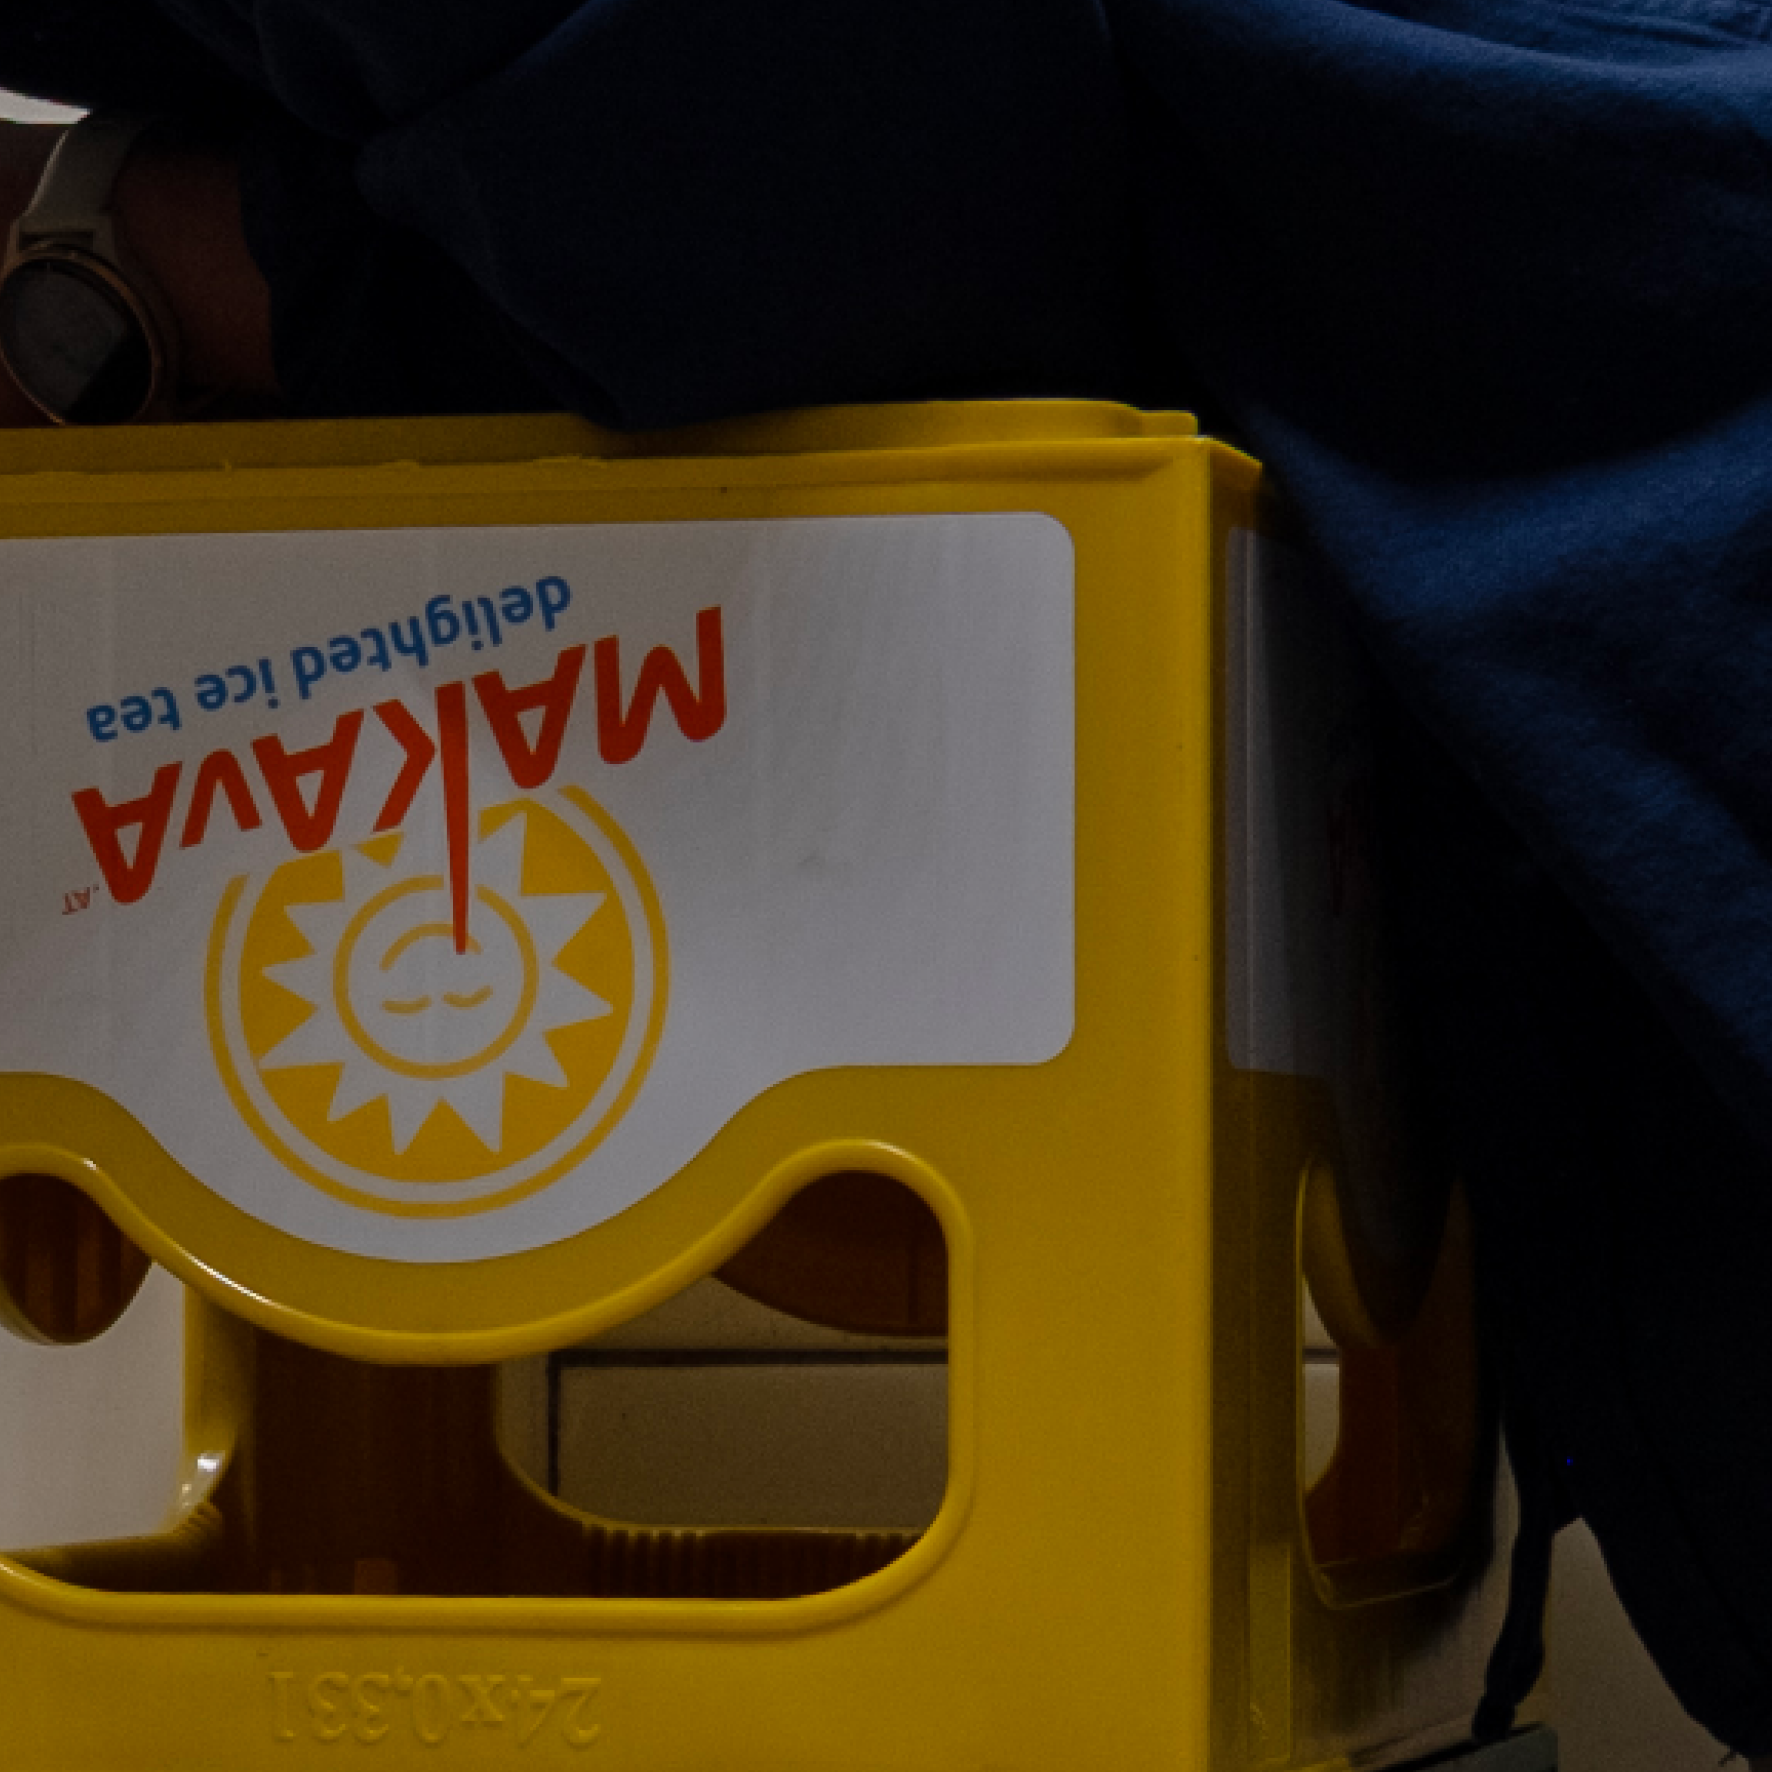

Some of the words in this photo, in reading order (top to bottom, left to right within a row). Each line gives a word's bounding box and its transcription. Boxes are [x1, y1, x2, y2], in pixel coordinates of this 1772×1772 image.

[293, 576, 571, 699] delighted
[197, 664, 276, 710] ice
[86, 689, 180, 741] tea
